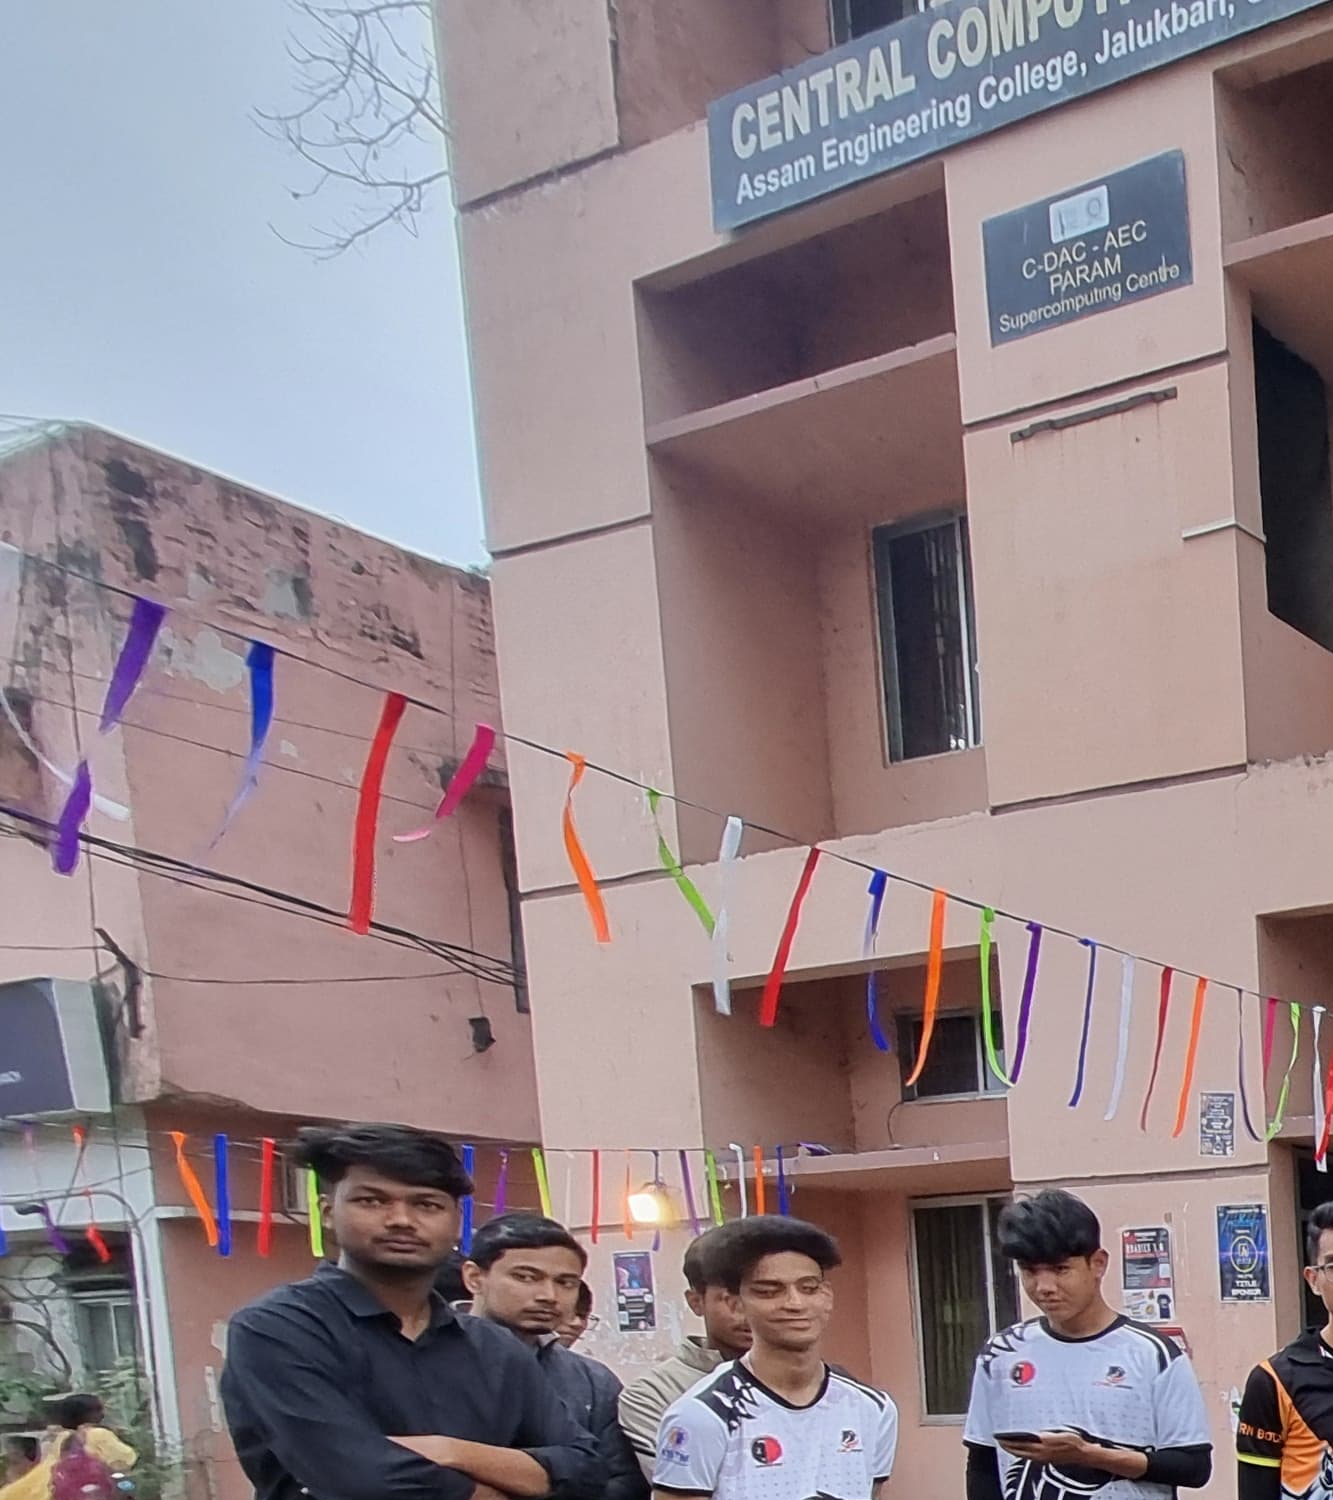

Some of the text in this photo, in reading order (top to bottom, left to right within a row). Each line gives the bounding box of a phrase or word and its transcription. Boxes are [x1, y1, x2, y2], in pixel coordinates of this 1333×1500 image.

[731, 39, 915, 159] CENTRAL
[736, 155, 815, 204] Assam
[822, 91, 971, 171] Engineering
[979, 50, 1087, 110] College,
[1022, 241, 1087, 280] C-DAC
[1104, 219, 1148, 252] AEC
[1049, 253, 1122, 296] PARAM
[999, 281, 1122, 333] Supercomputing
